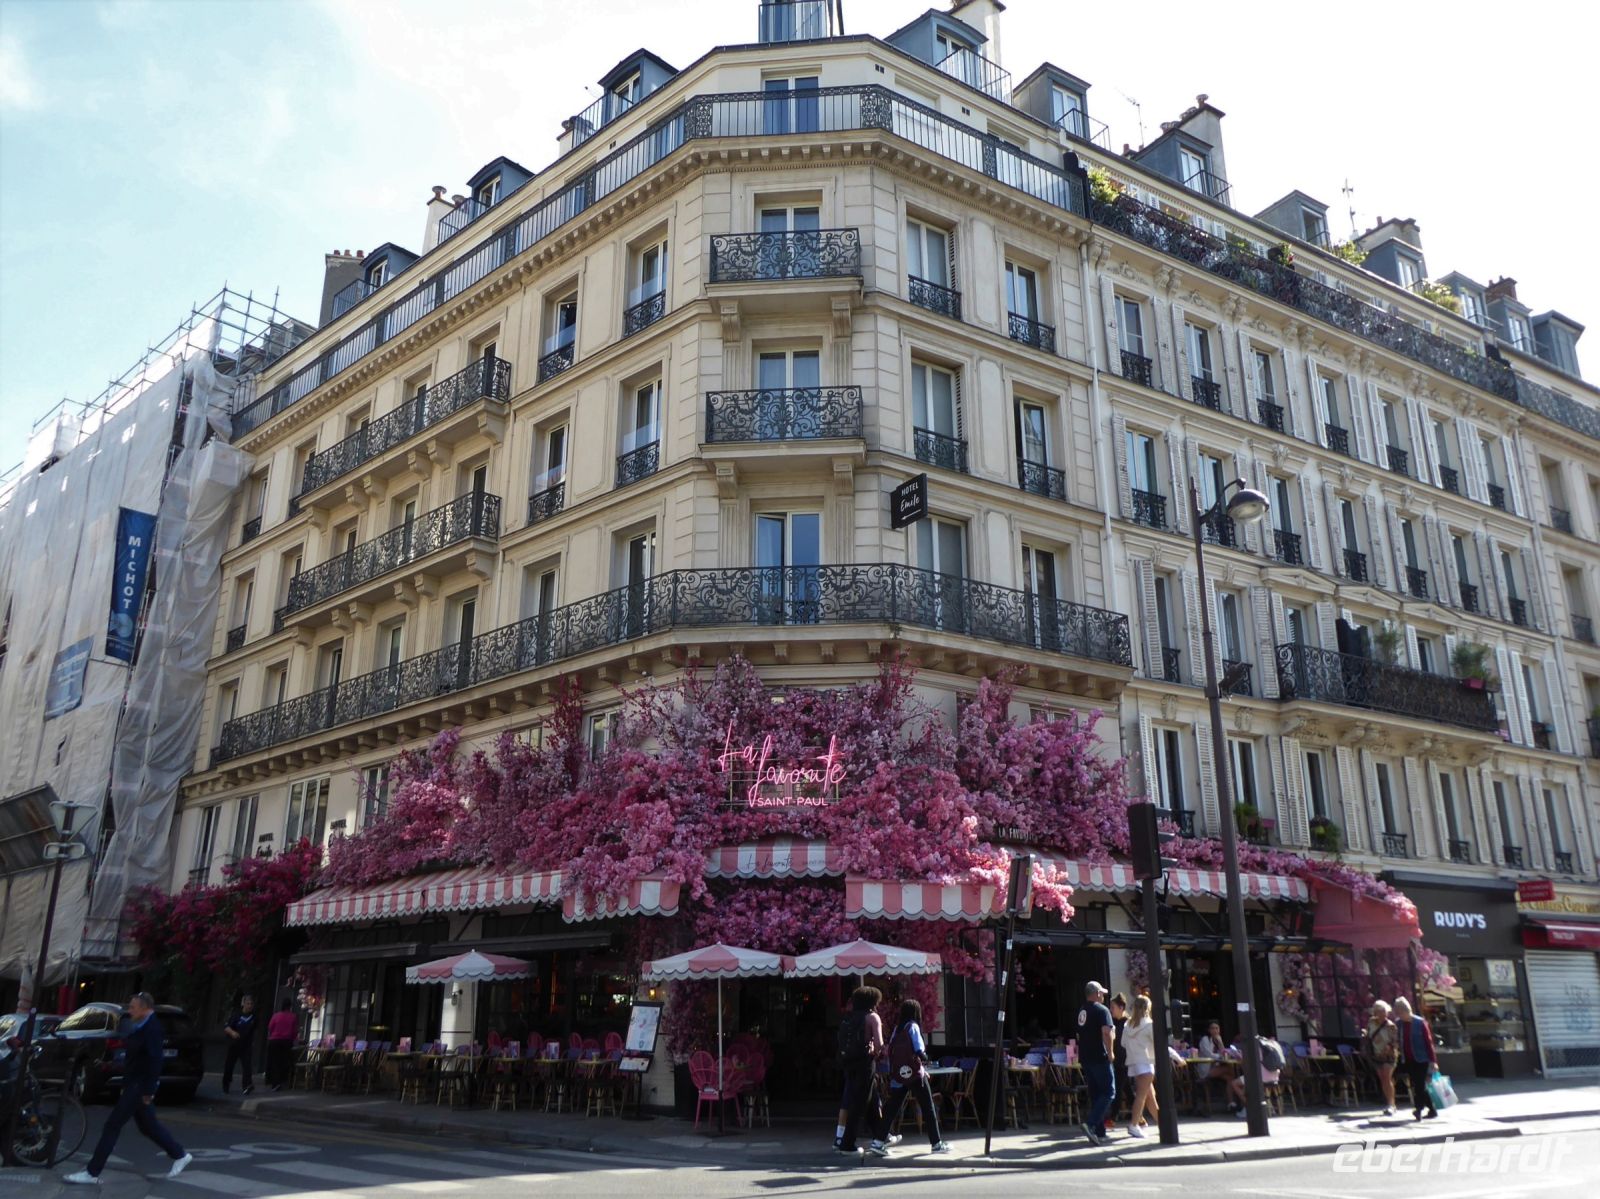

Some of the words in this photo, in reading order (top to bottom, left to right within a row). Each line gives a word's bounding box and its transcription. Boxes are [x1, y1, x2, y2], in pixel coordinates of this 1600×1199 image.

[901, 481, 919, 496] HOTEL
[900, 494, 920, 512] Emile
[123, 536, 141, 609] MICHOT
[757, 796, 828, 807] SAINT-PAUL
[998, 827, 1006, 838] LA
[1433, 911, 1487, 929] RUDY'S
